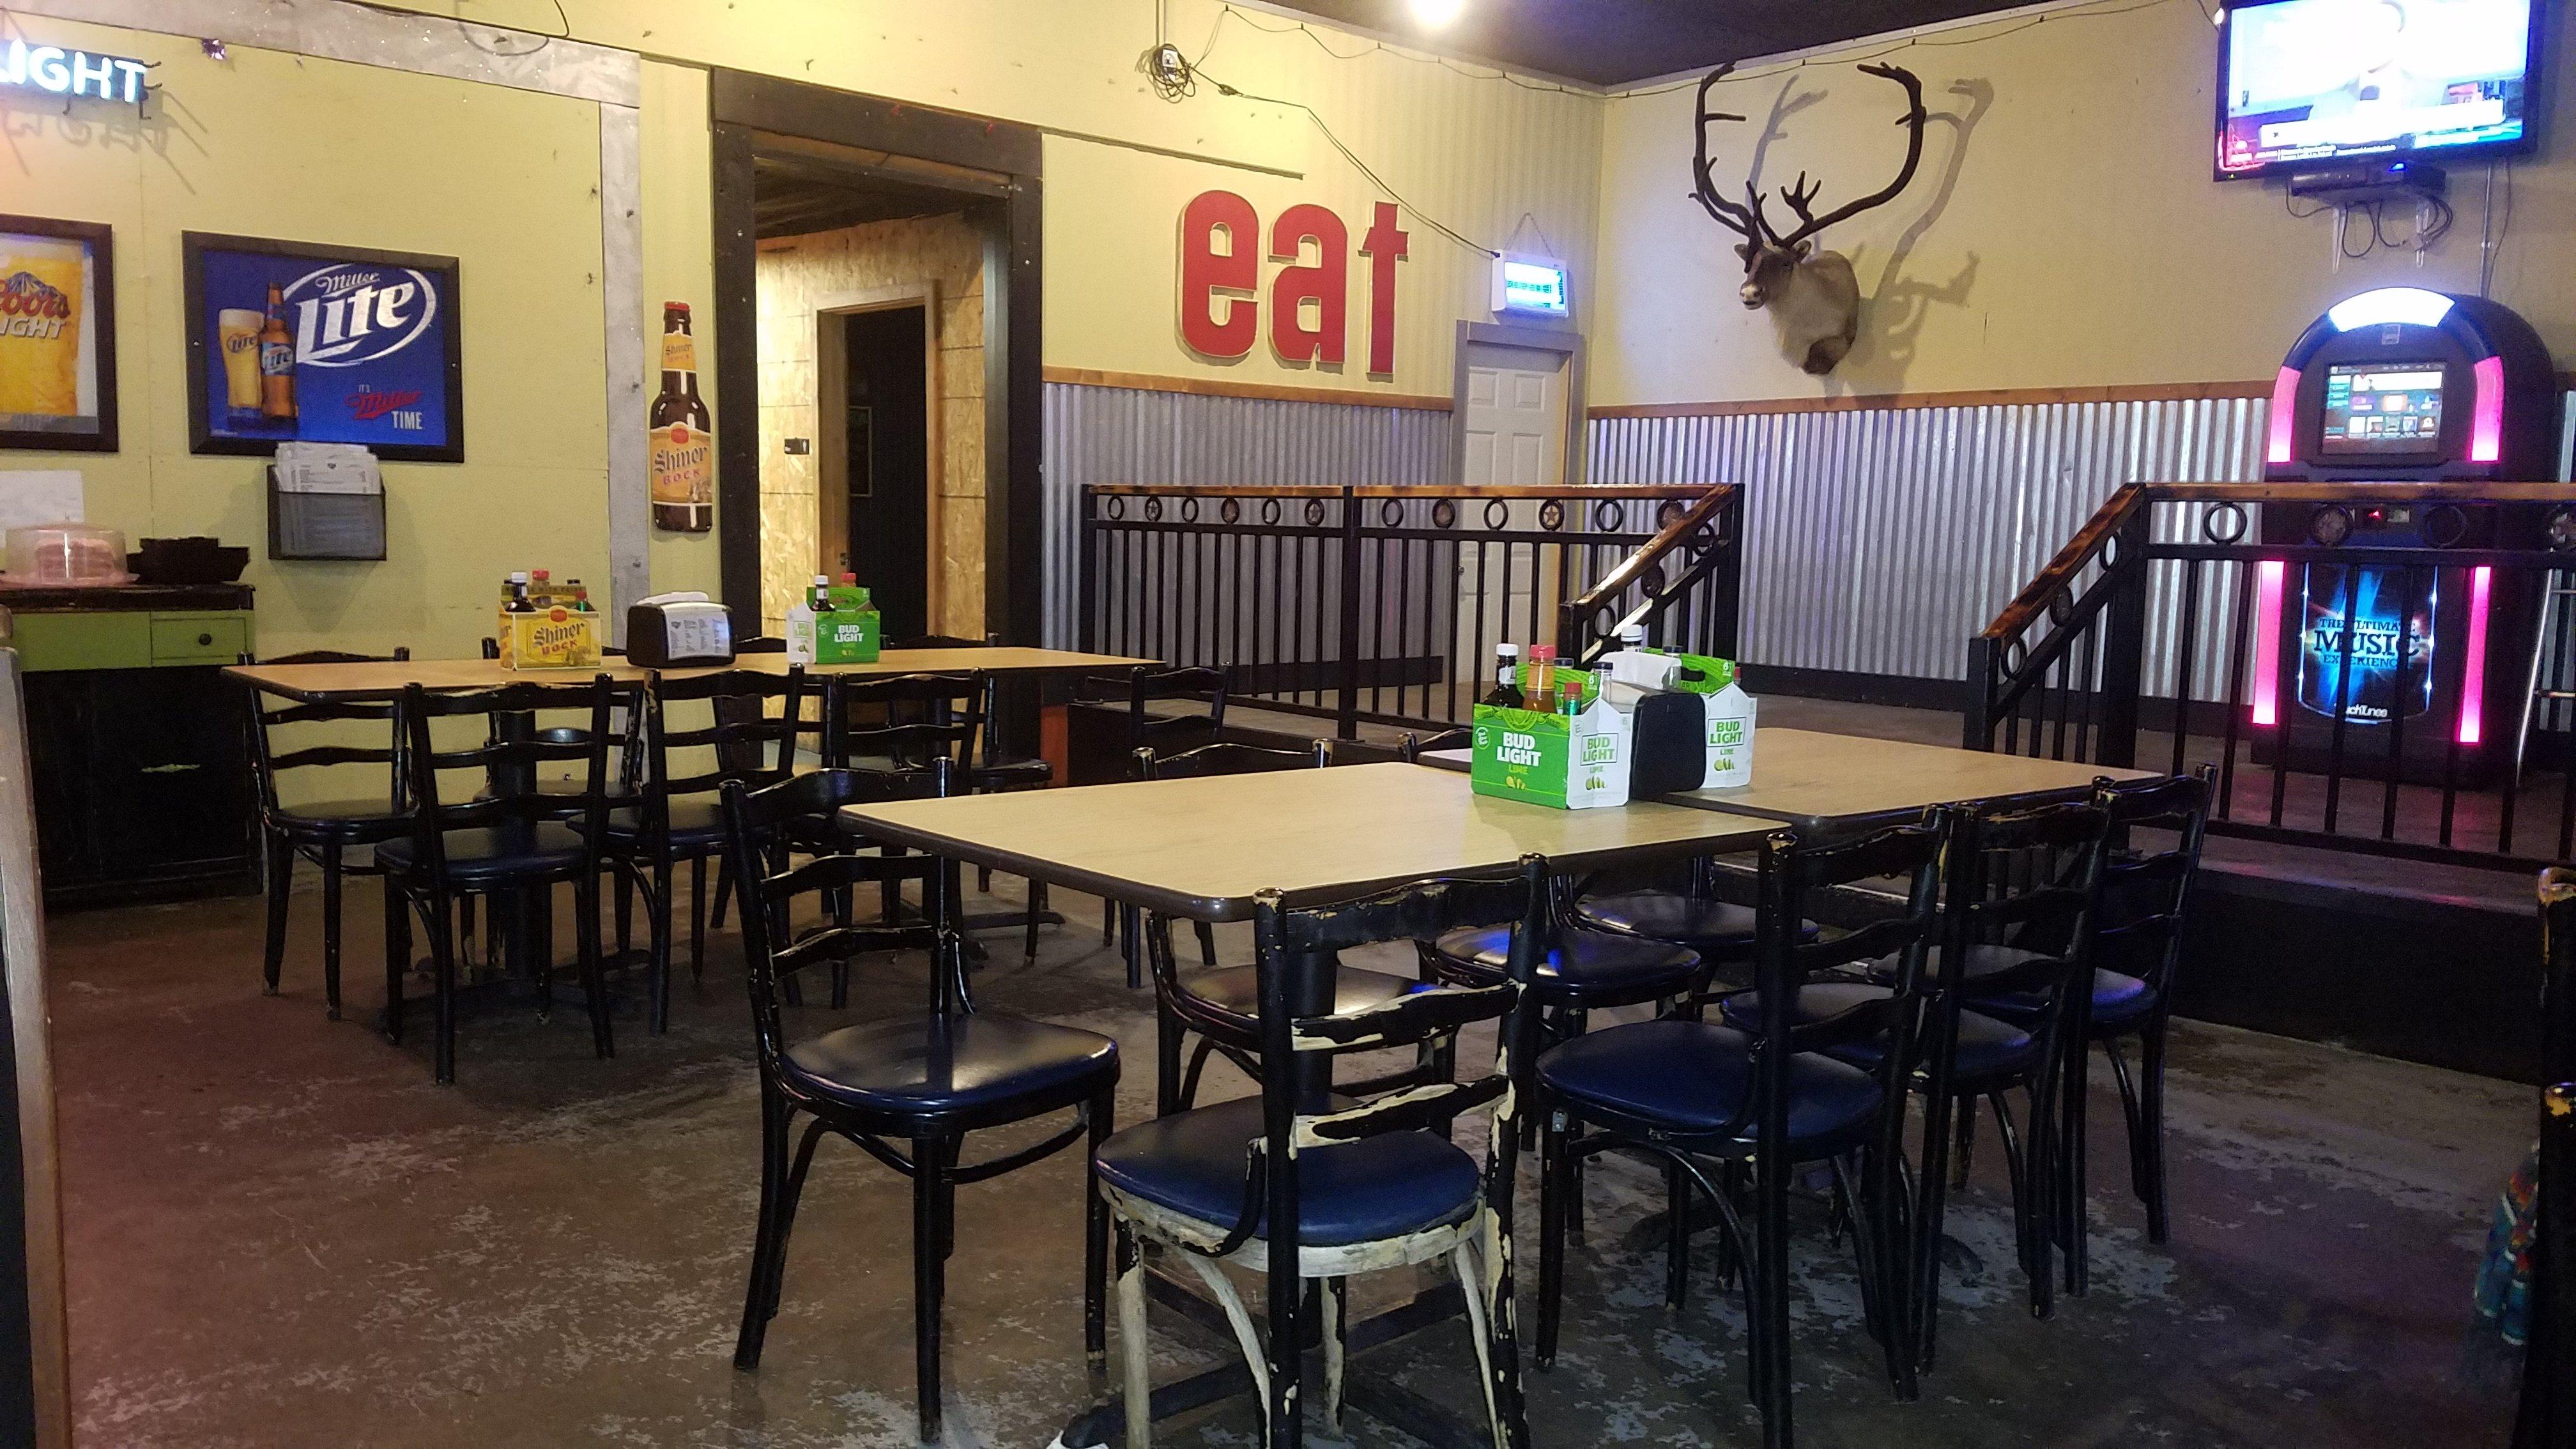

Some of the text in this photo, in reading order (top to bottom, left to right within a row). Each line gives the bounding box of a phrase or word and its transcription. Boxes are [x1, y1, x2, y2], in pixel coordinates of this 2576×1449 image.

[315, 272, 380, 298] Miller
[1179, 189, 1409, 374] eat
[0, 317, 67, 340] IGHT
[296, 282, 415, 363] Lite
[391, 411, 422, 429] TIME
[654, 447, 708, 473] Shiner
[663, 469, 701, 486] BOCK
[532, 622, 585, 648] Shiner
[834, 633, 864, 643] LIGHT
[838, 624, 860, 634] BUD
[1715, 721, 1740, 732] BUD
[1503, 732, 1535, 750] BUD
[1587, 737, 1611, 749] BUD
[1710, 732, 1743, 744] LIGHT
[1496, 746, 1542, 767] LIGHT
[1583, 748, 1615, 762] LIGHT
